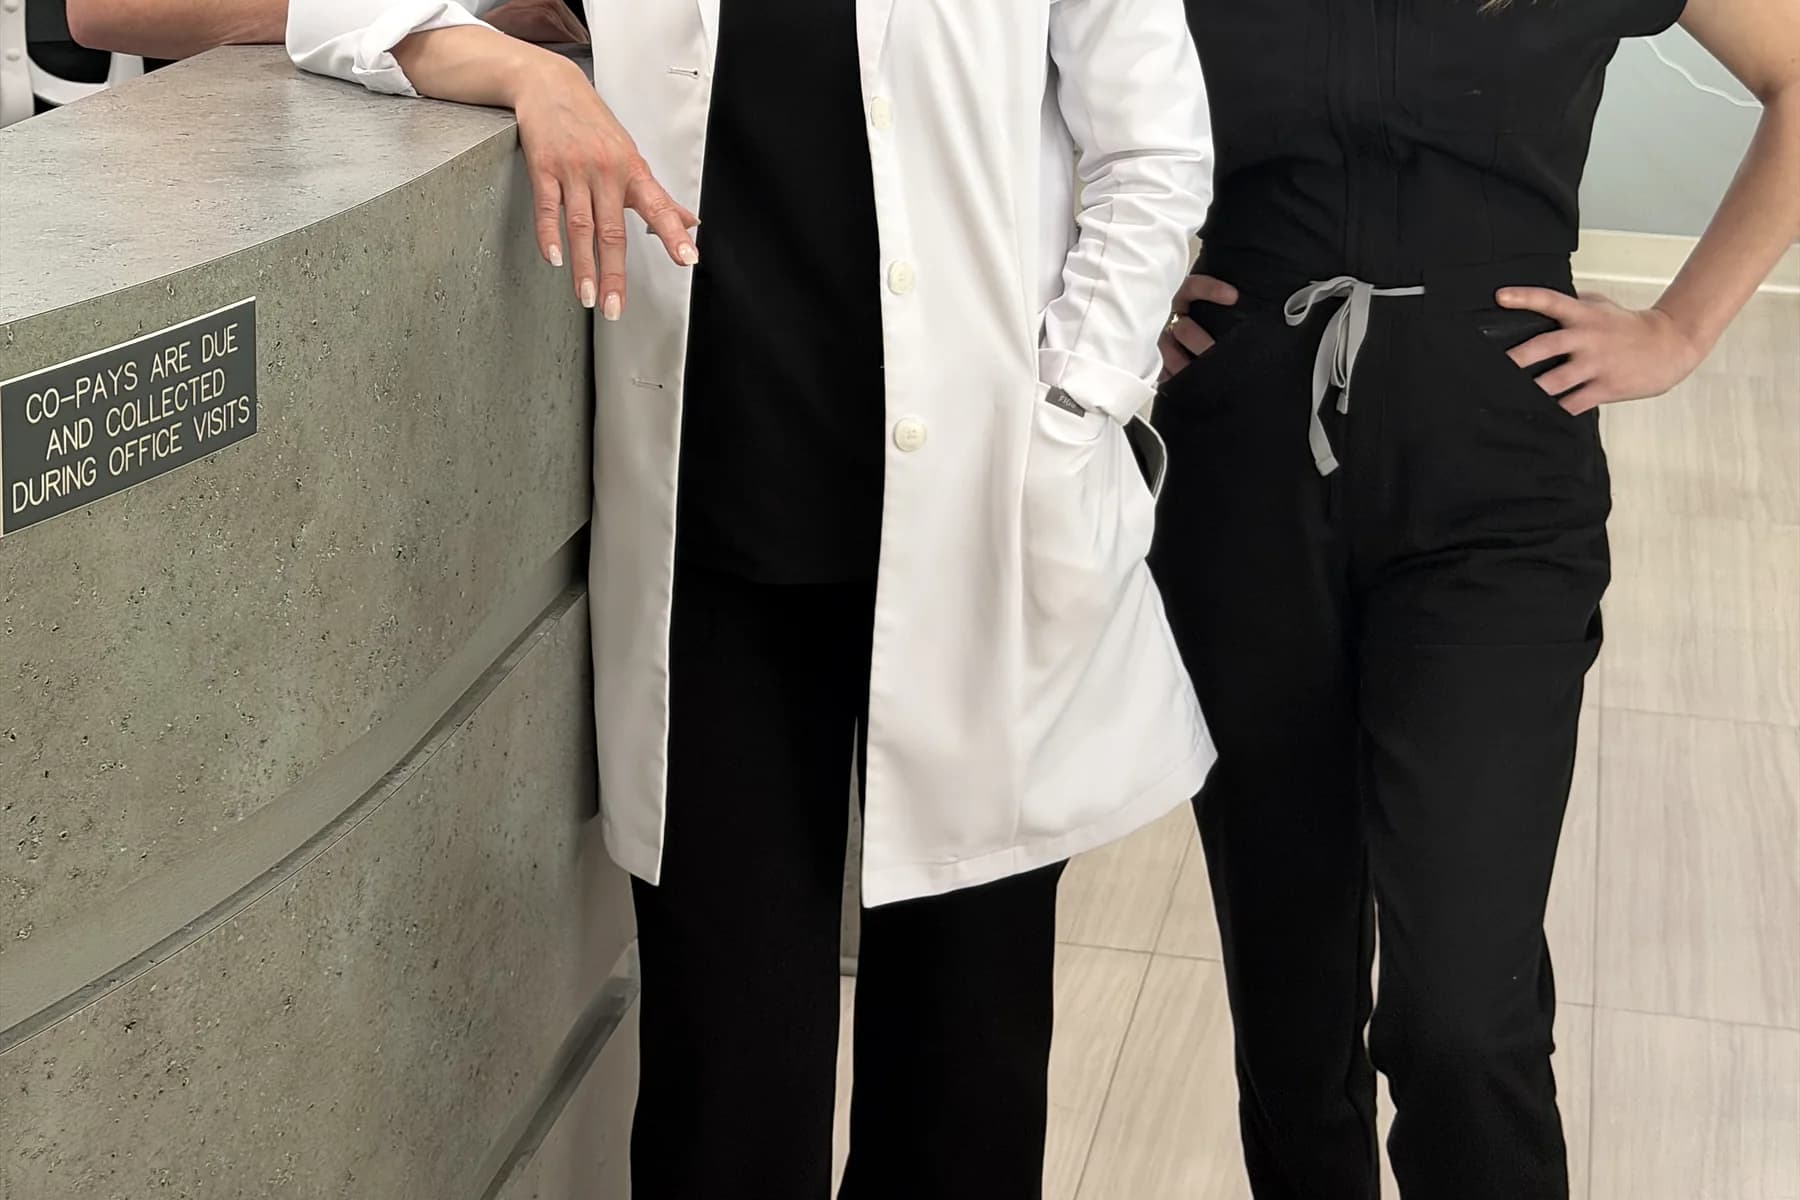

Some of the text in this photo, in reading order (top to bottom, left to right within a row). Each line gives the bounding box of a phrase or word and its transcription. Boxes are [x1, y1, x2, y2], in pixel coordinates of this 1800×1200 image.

[26, 323, 238, 423] CO-PAYS ARE DUE
[46, 368, 225, 460] AND COLLECTED
[13, 396, 250, 513] DURING OFFICE VISITS
